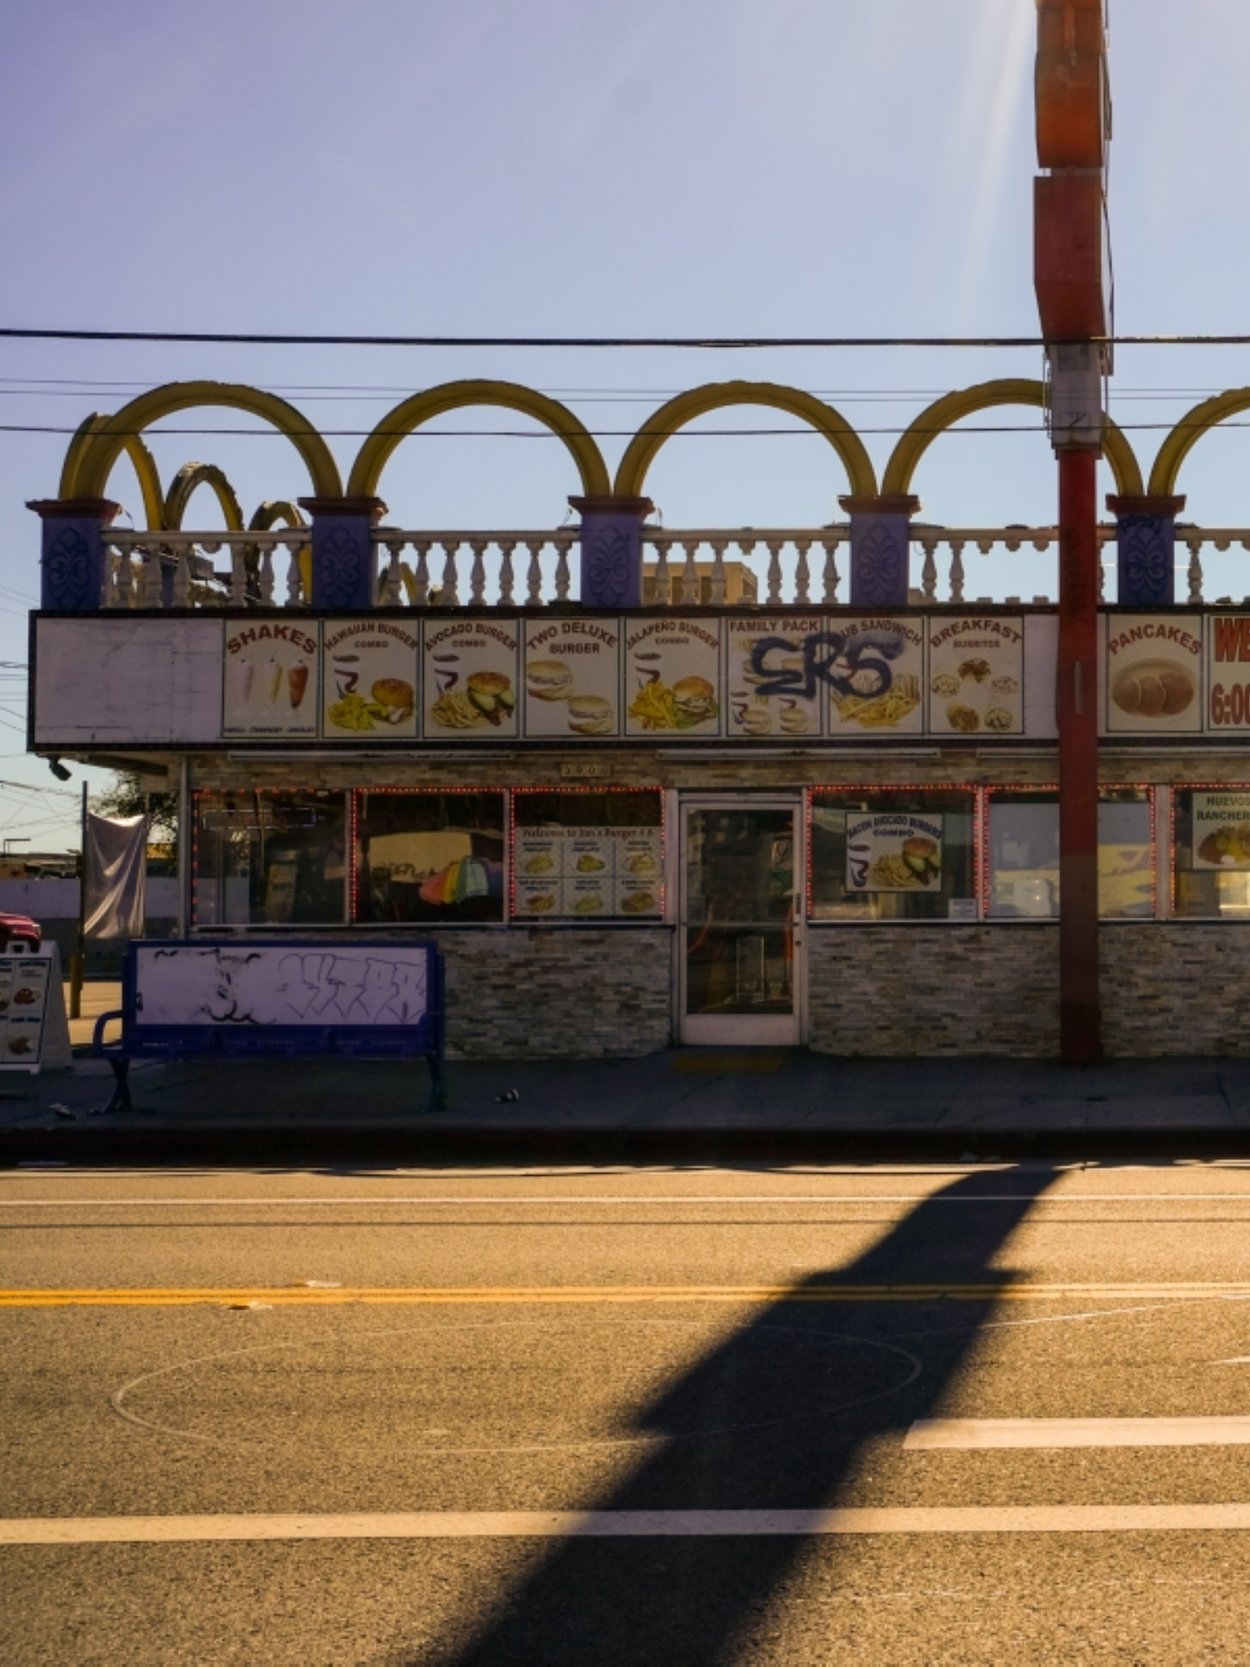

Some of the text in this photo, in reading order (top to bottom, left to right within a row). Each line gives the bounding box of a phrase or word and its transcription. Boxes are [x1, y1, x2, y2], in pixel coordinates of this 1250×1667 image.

[227, 624, 317, 655] SHAKES
[378, 622, 418, 650] BURGER
[425, 622, 518, 651] AVOCADO BURGER
[527, 622, 618, 650] TWO DELUXE
[679, 622, 719, 650] BURGER
[730, 619, 819, 632] FAMILY PACK
[861, 619, 922, 646] SANDWICH
[930, 619, 1023, 648] BREAKFAST
[1108, 623, 1202, 655] PANCAKES
[354, 640, 389, 648] COMBO
[451, 640, 487, 648] COMBO
[549, 643, 601, 654] BURGER
[873, 828, 914, 837] COMBO
